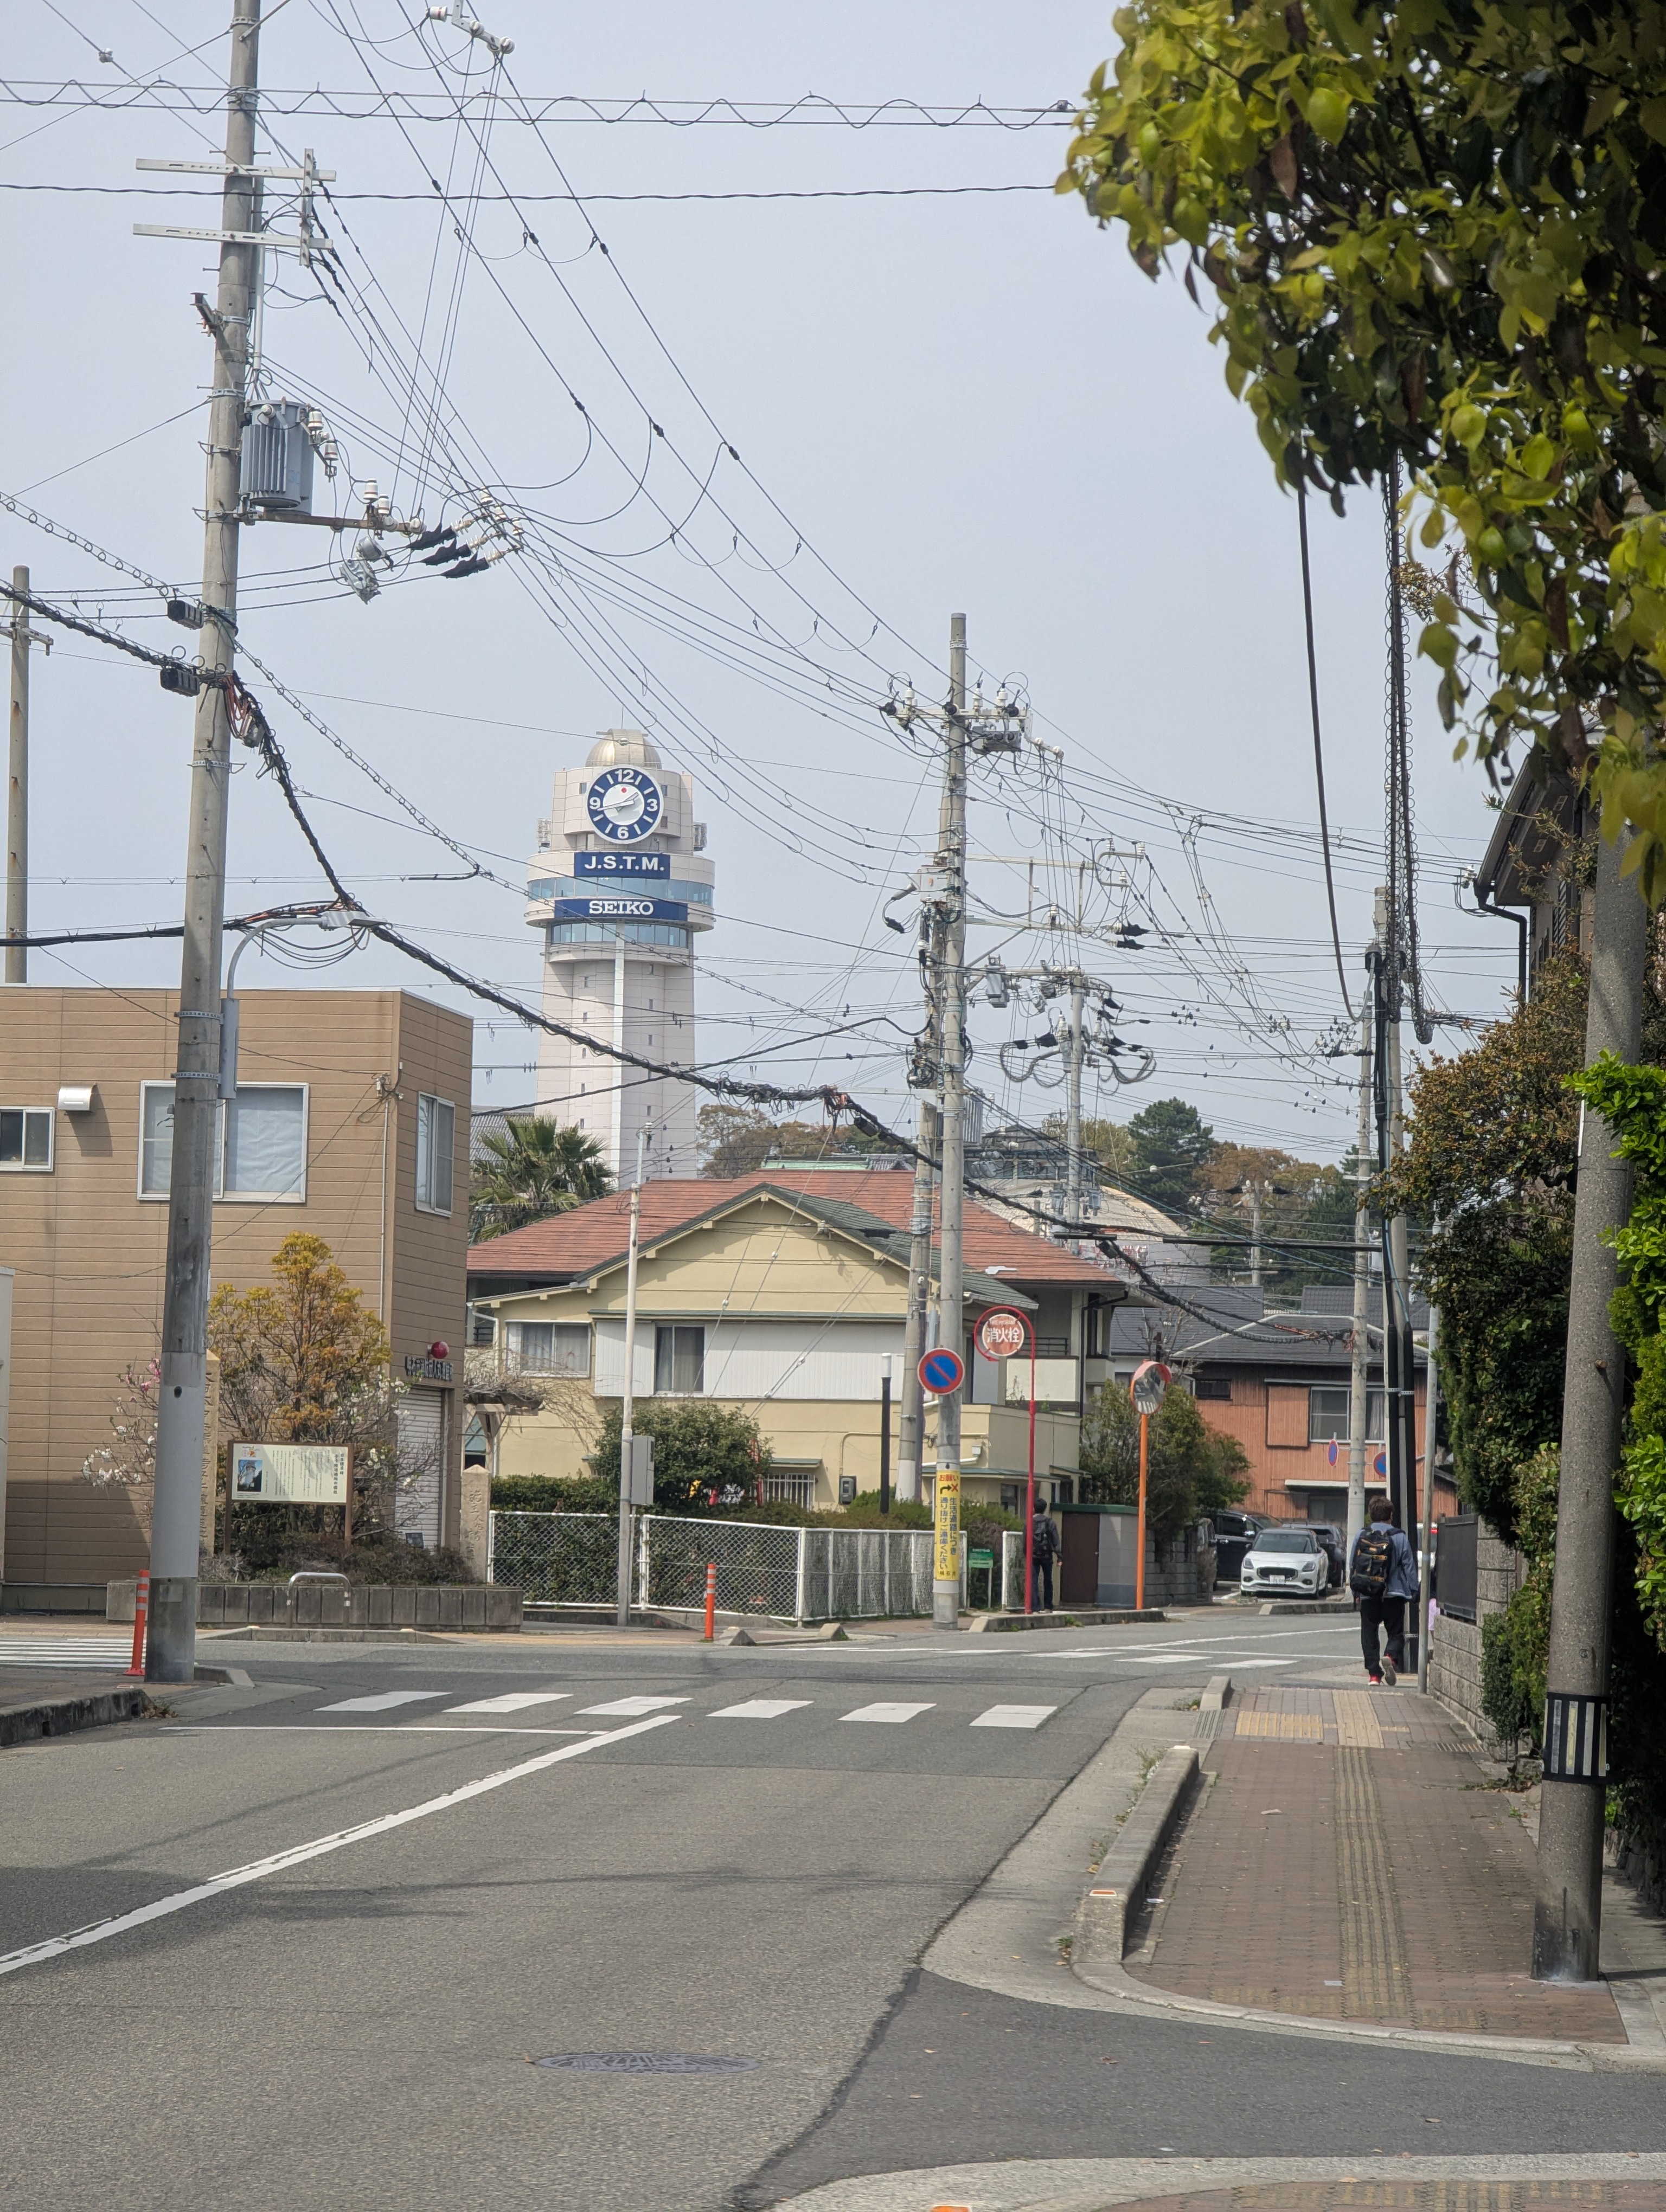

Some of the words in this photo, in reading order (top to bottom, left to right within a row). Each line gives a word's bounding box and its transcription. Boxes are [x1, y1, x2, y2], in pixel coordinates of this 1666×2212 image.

[615, 769, 634, 782] 12
[589, 797, 601, 809] 9
[646, 799, 658, 811] 3
[617, 826, 629, 839] 6
[585, 856, 664, 871] J.S.T.M.
[589, 900, 654, 915] SEIKO
[987, 1327, 1020, 1343] 消火栓
